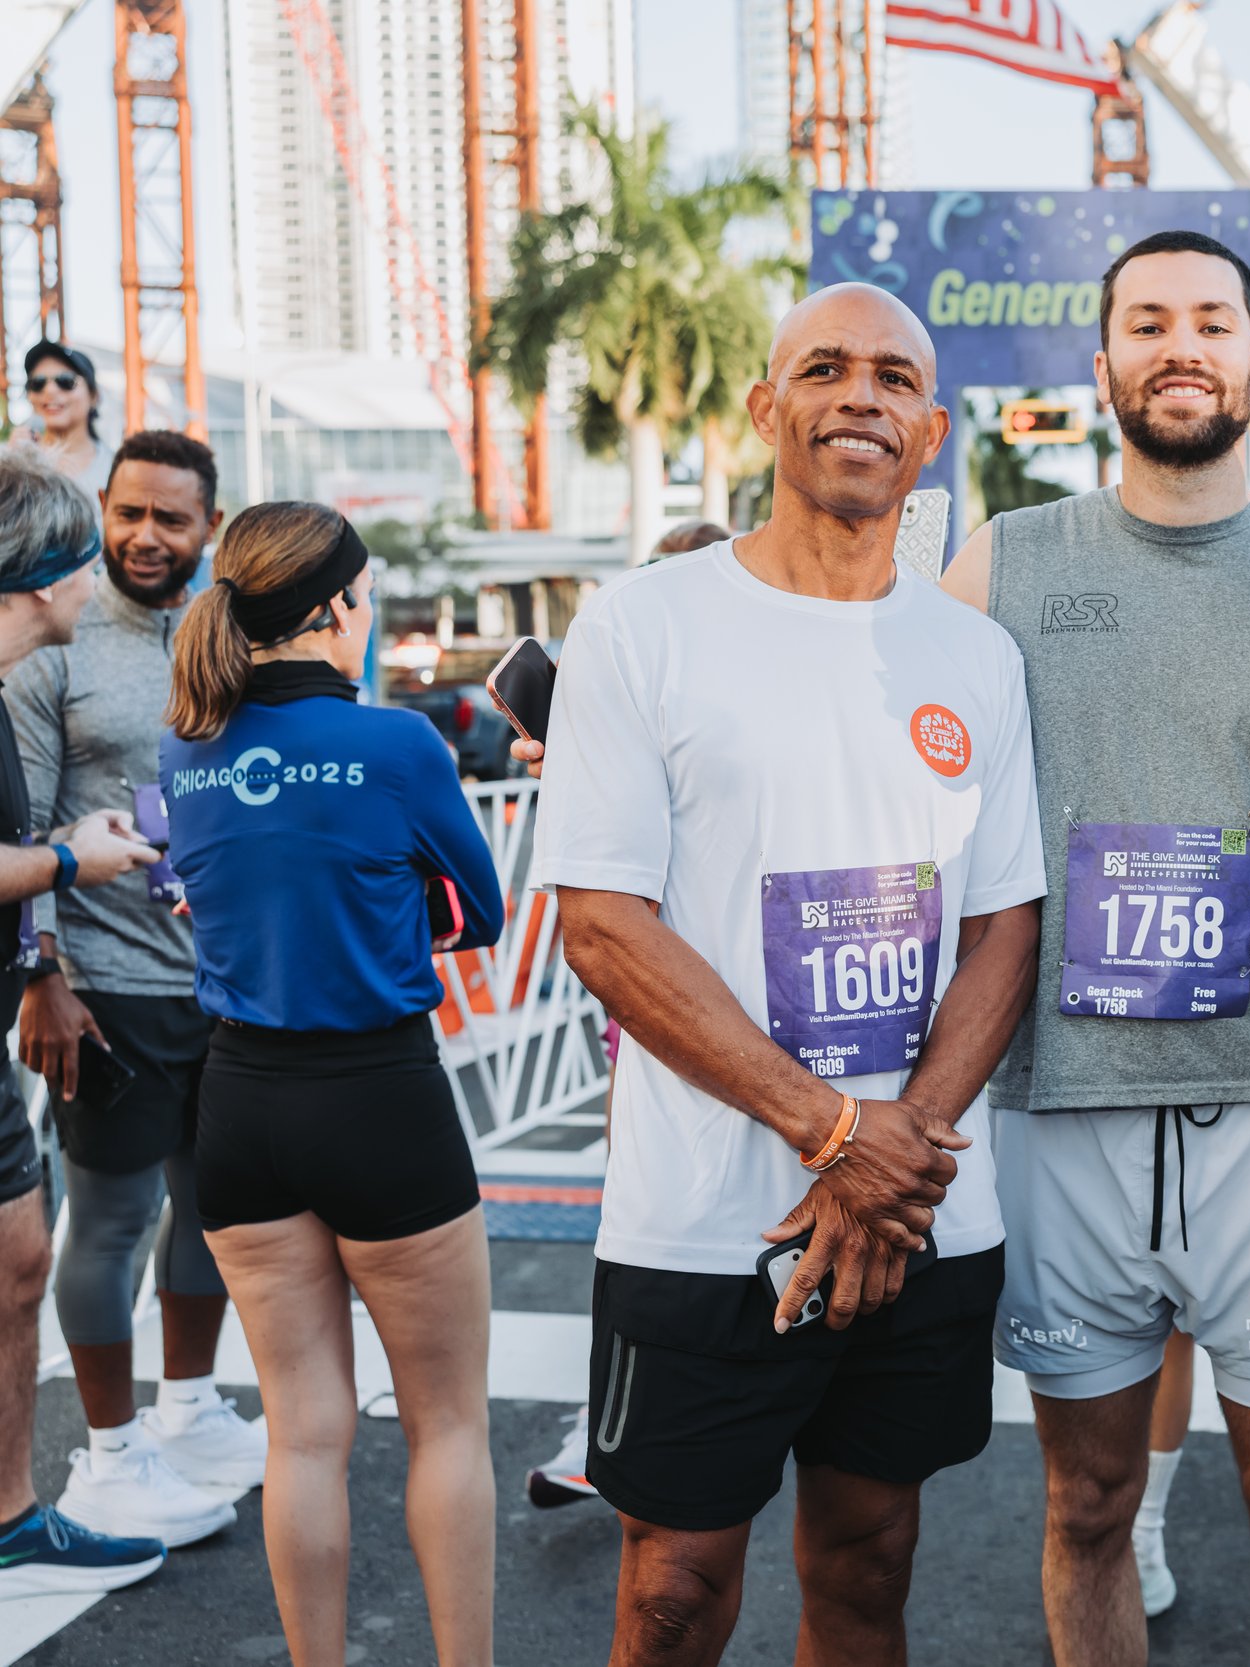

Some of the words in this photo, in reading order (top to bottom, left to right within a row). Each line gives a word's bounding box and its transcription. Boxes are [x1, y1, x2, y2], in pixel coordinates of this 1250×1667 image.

[927, 269, 1101, 328] Genero
[1041, 592, 1120, 629] RSR
[929, 733, 958, 750] KIDS
[173, 766, 247, 799] CHICAGO
[283, 762, 365, 786] 2025
[1176, 831, 1191, 839] Scan
[1130, 851, 1150, 861] THE
[1152, 852, 1175, 862] GIVE
[1177, 853, 1206, 863] MIAMI
[1207, 854, 1221, 864] 5K
[1119, 883, 1137, 891] Hosted
[1137, 884, 1145, 892] by
[1156, 884, 1173, 892] Miami
[1173, 885, 1203, 893] Foundation
[832, 900, 853, 910] THE
[855, 897, 878, 908] GIVE
[880, 895, 906, 905] MIAMI
[907, 892, 918, 903] 5K
[1098, 894, 1224, 959] 1758
[822, 934, 843, 943] Hosted
[843, 934, 851, 942] by
[851, 931, 862, 939] The
[862, 930, 879, 939] Miami
[879, 928, 905, 938] Foundation
[1100, 957, 1113, 965] Visit
[1113, 958, 1165, 967] GiveMiamiDay.org
[801, 937, 924, 1012] 1609
[1087, 985, 1110, 997] Gear
[1112, 986, 1144, 999] Check
[1193, 987, 1216, 998] Free
[886, 1008, 897, 1016] find
[896, 1008, 908, 1016] your
[1094, 997, 1128, 1015] 1758
[1190, 1001, 1217, 1013] Swag
[906, 1033, 920, 1044] Free
[799, 1047, 824, 1059] Gear
[826, 1043, 860, 1057] Check
[809, 1057, 845, 1077] 1609
[822, 1142, 838, 1158] DIAL
[1020, 1325, 1079, 1345] ASRV
